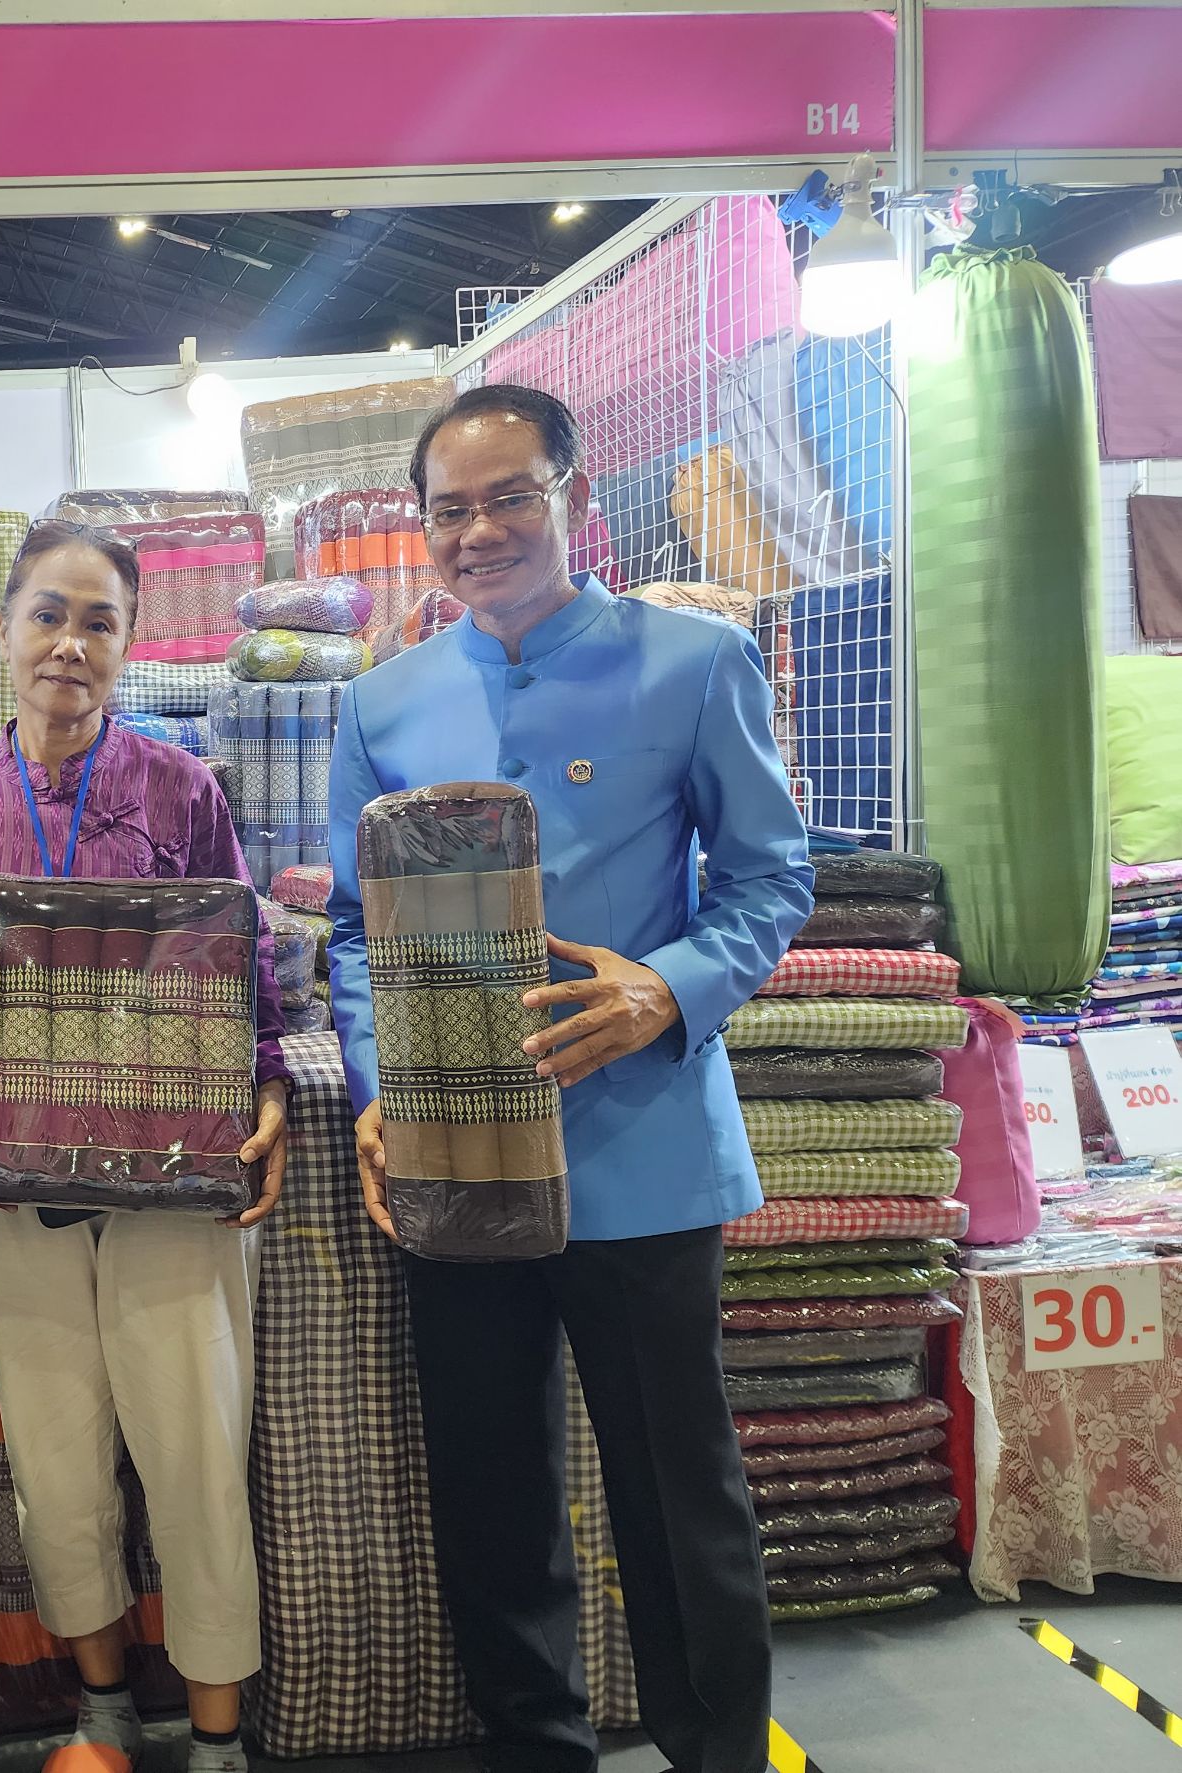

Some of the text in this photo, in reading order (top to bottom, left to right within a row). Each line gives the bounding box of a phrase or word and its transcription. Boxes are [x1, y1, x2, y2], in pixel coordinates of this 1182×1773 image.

[806, 102, 861, 136] B14
[1122, 1084, 1179, 1108] 200.
[1033, 1284, 1156, 1353] 30.-
